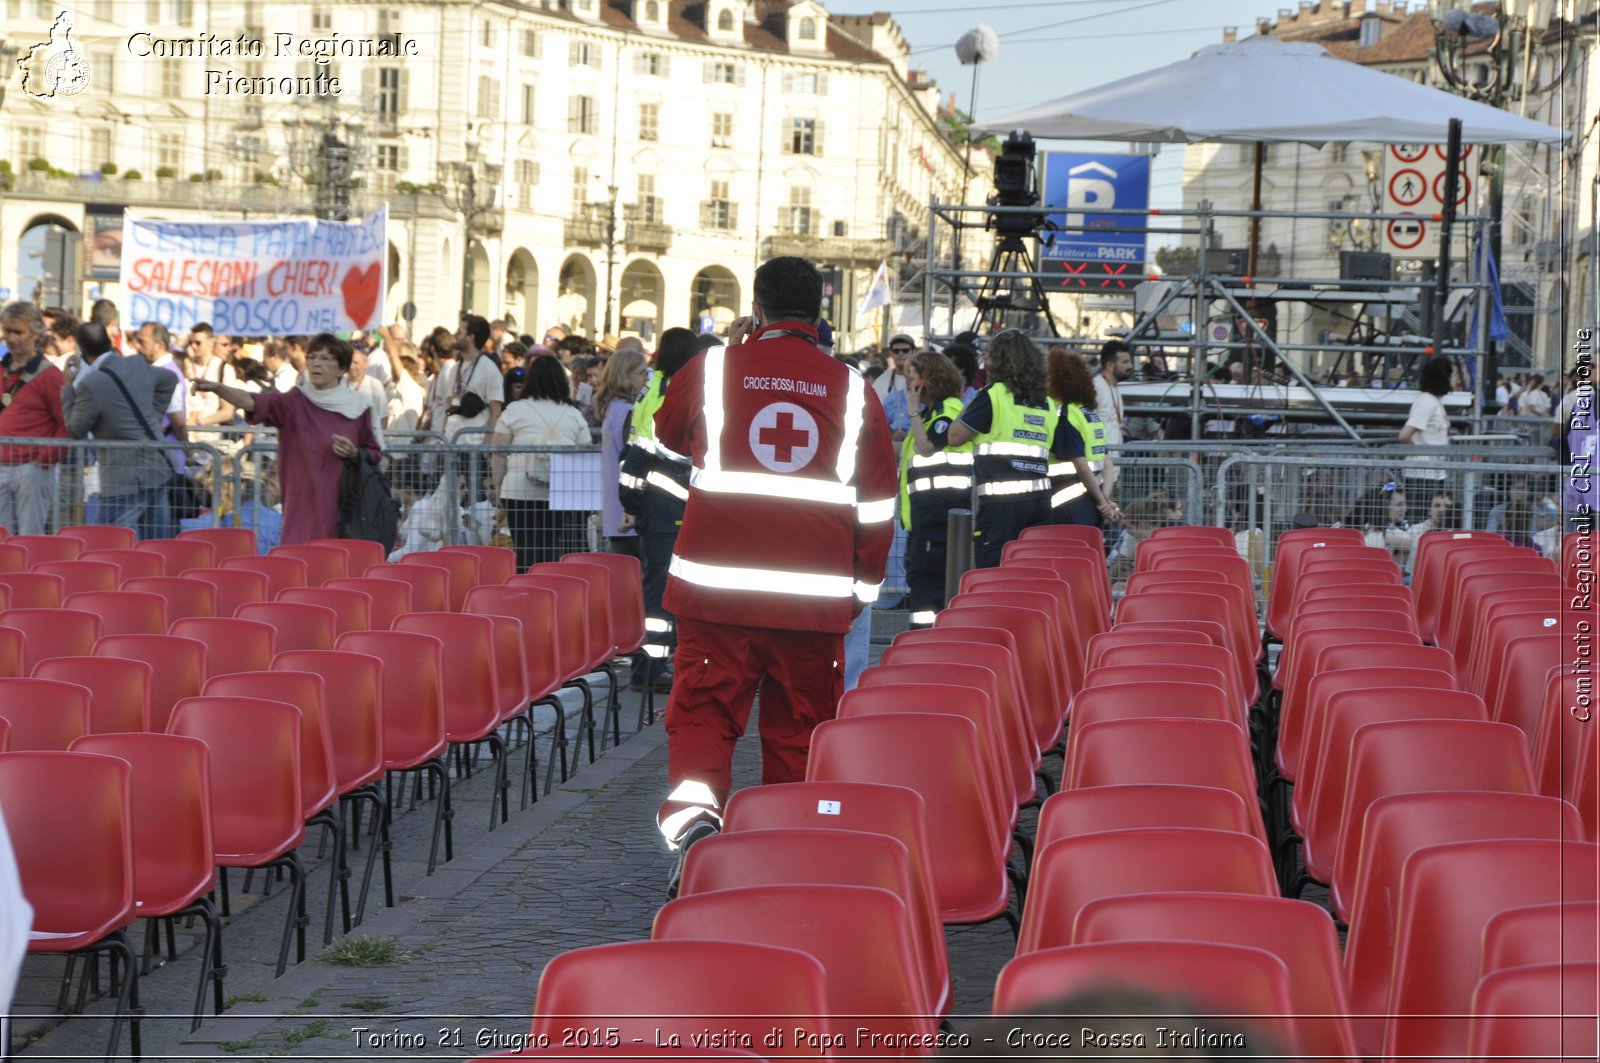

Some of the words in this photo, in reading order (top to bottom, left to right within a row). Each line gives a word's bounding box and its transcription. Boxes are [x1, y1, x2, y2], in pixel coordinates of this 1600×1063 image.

[127, 257, 259, 299] SALESIANI
[130, 292, 199, 332] DON
[211, 298, 300, 334] BOSCO
[305, 308, 342, 332] NEL
[743, 376, 770, 390] CROCE
[771, 377, 795, 392] ROSSA
[796, 380, 827, 397] ITALIANA
